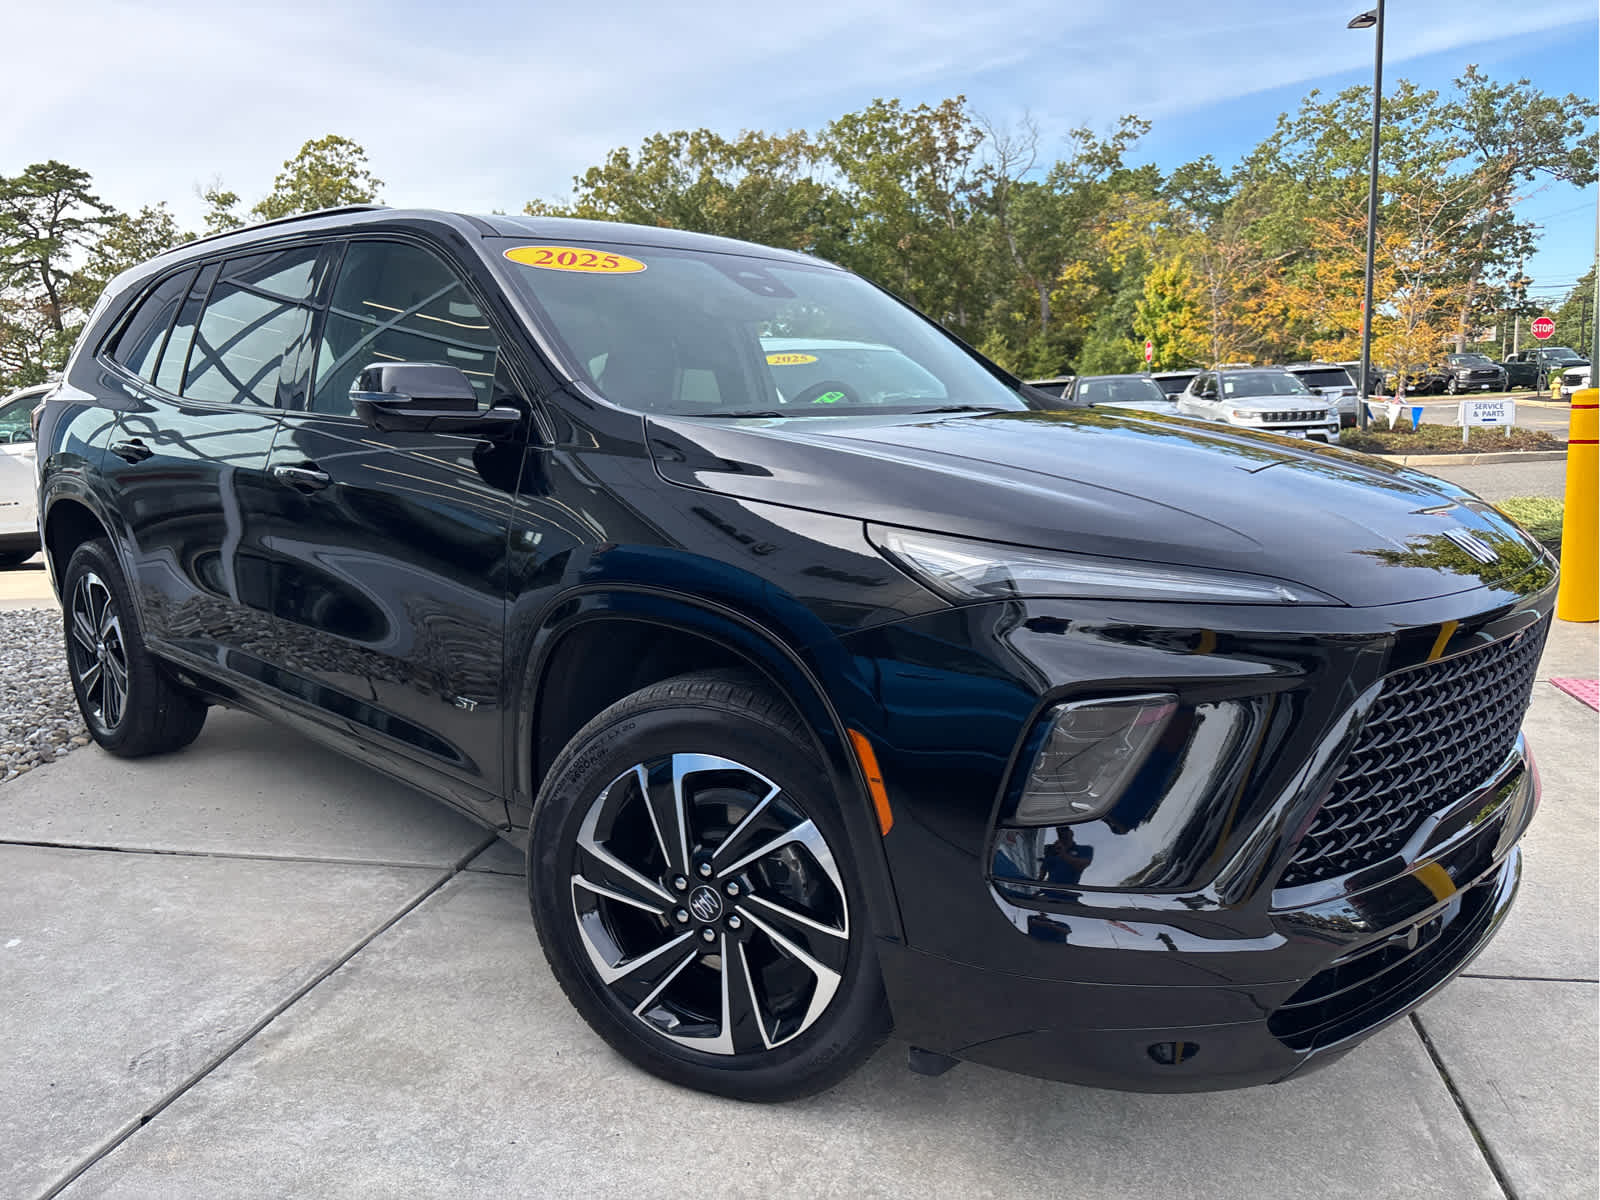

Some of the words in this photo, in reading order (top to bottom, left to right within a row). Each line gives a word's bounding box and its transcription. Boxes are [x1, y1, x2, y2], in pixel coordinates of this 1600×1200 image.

[533, 250, 619, 268] 2025
[1533, 323, 1553, 333] STOP
[775, 353, 808, 364] 2025
[456, 696, 478, 711] ST
